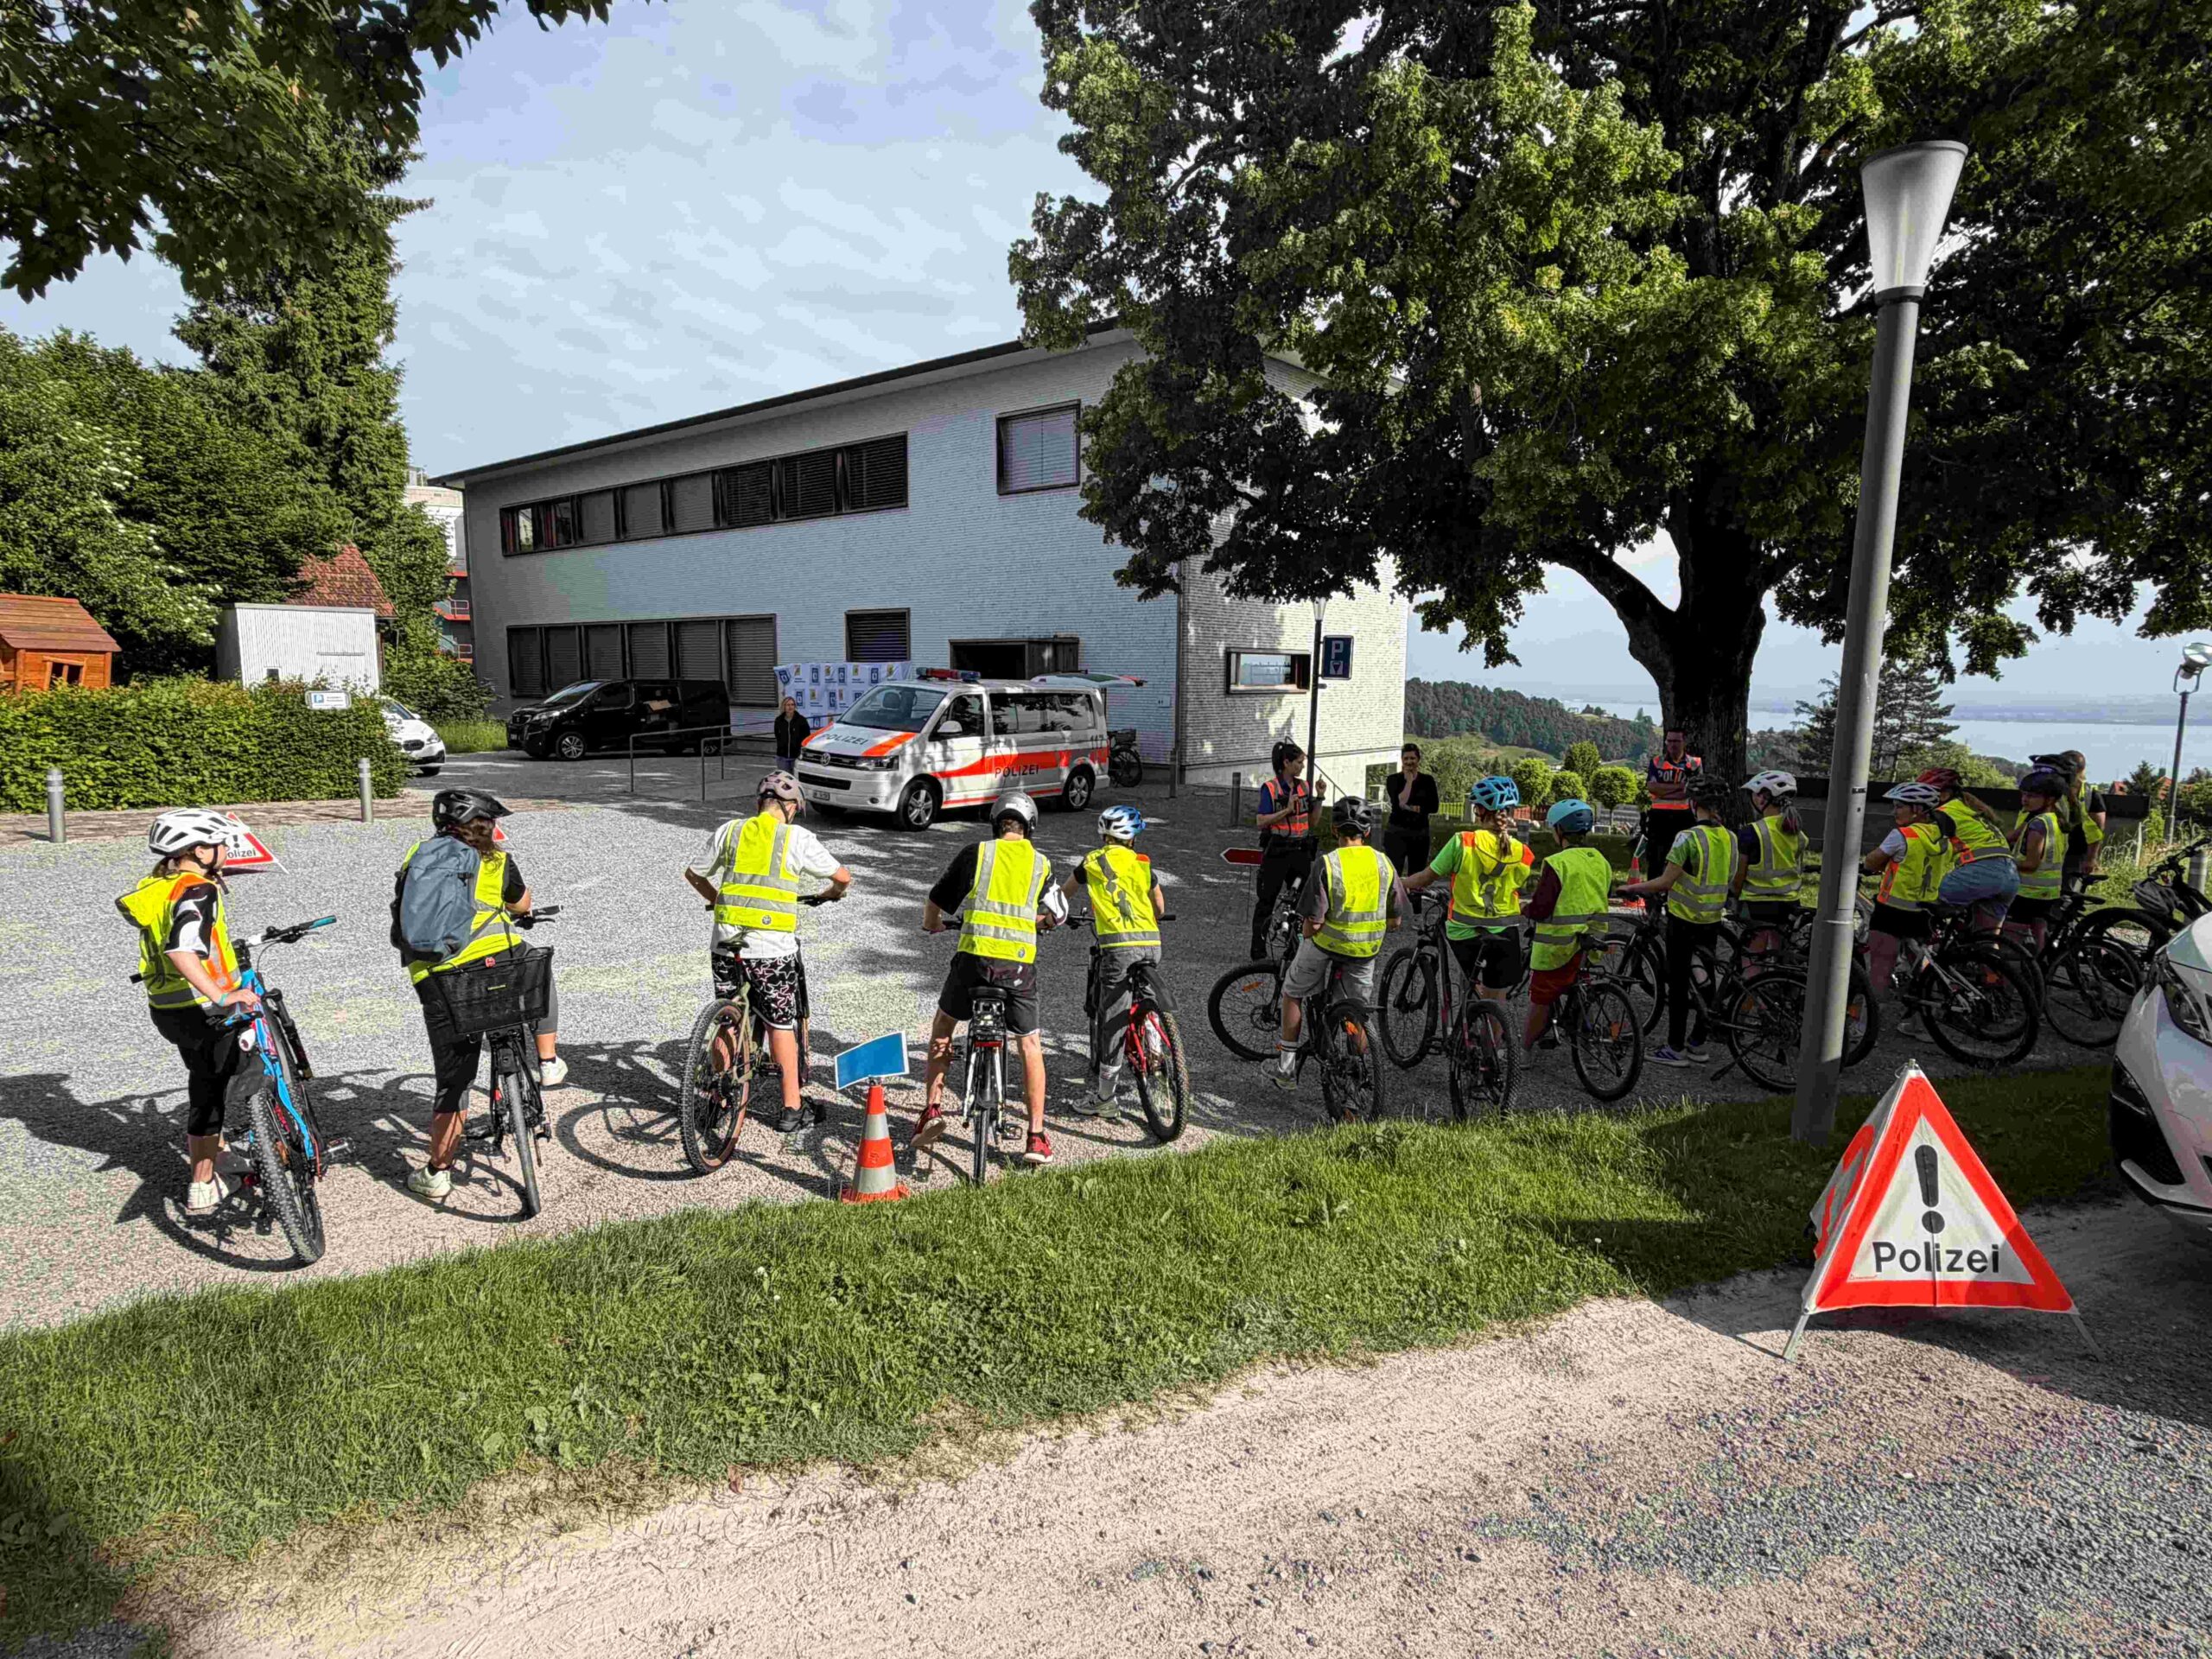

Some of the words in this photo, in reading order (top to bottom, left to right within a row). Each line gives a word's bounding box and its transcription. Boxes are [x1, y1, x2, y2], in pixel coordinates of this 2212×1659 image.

[1332, 640, 1344, 659] P
[1090, 734, 1104, 750] 117
[995, 764, 1039, 779] POLIZEI
[227, 849, 257, 859] olizei
[1872, 1241, 1999, 1273] Polizei
